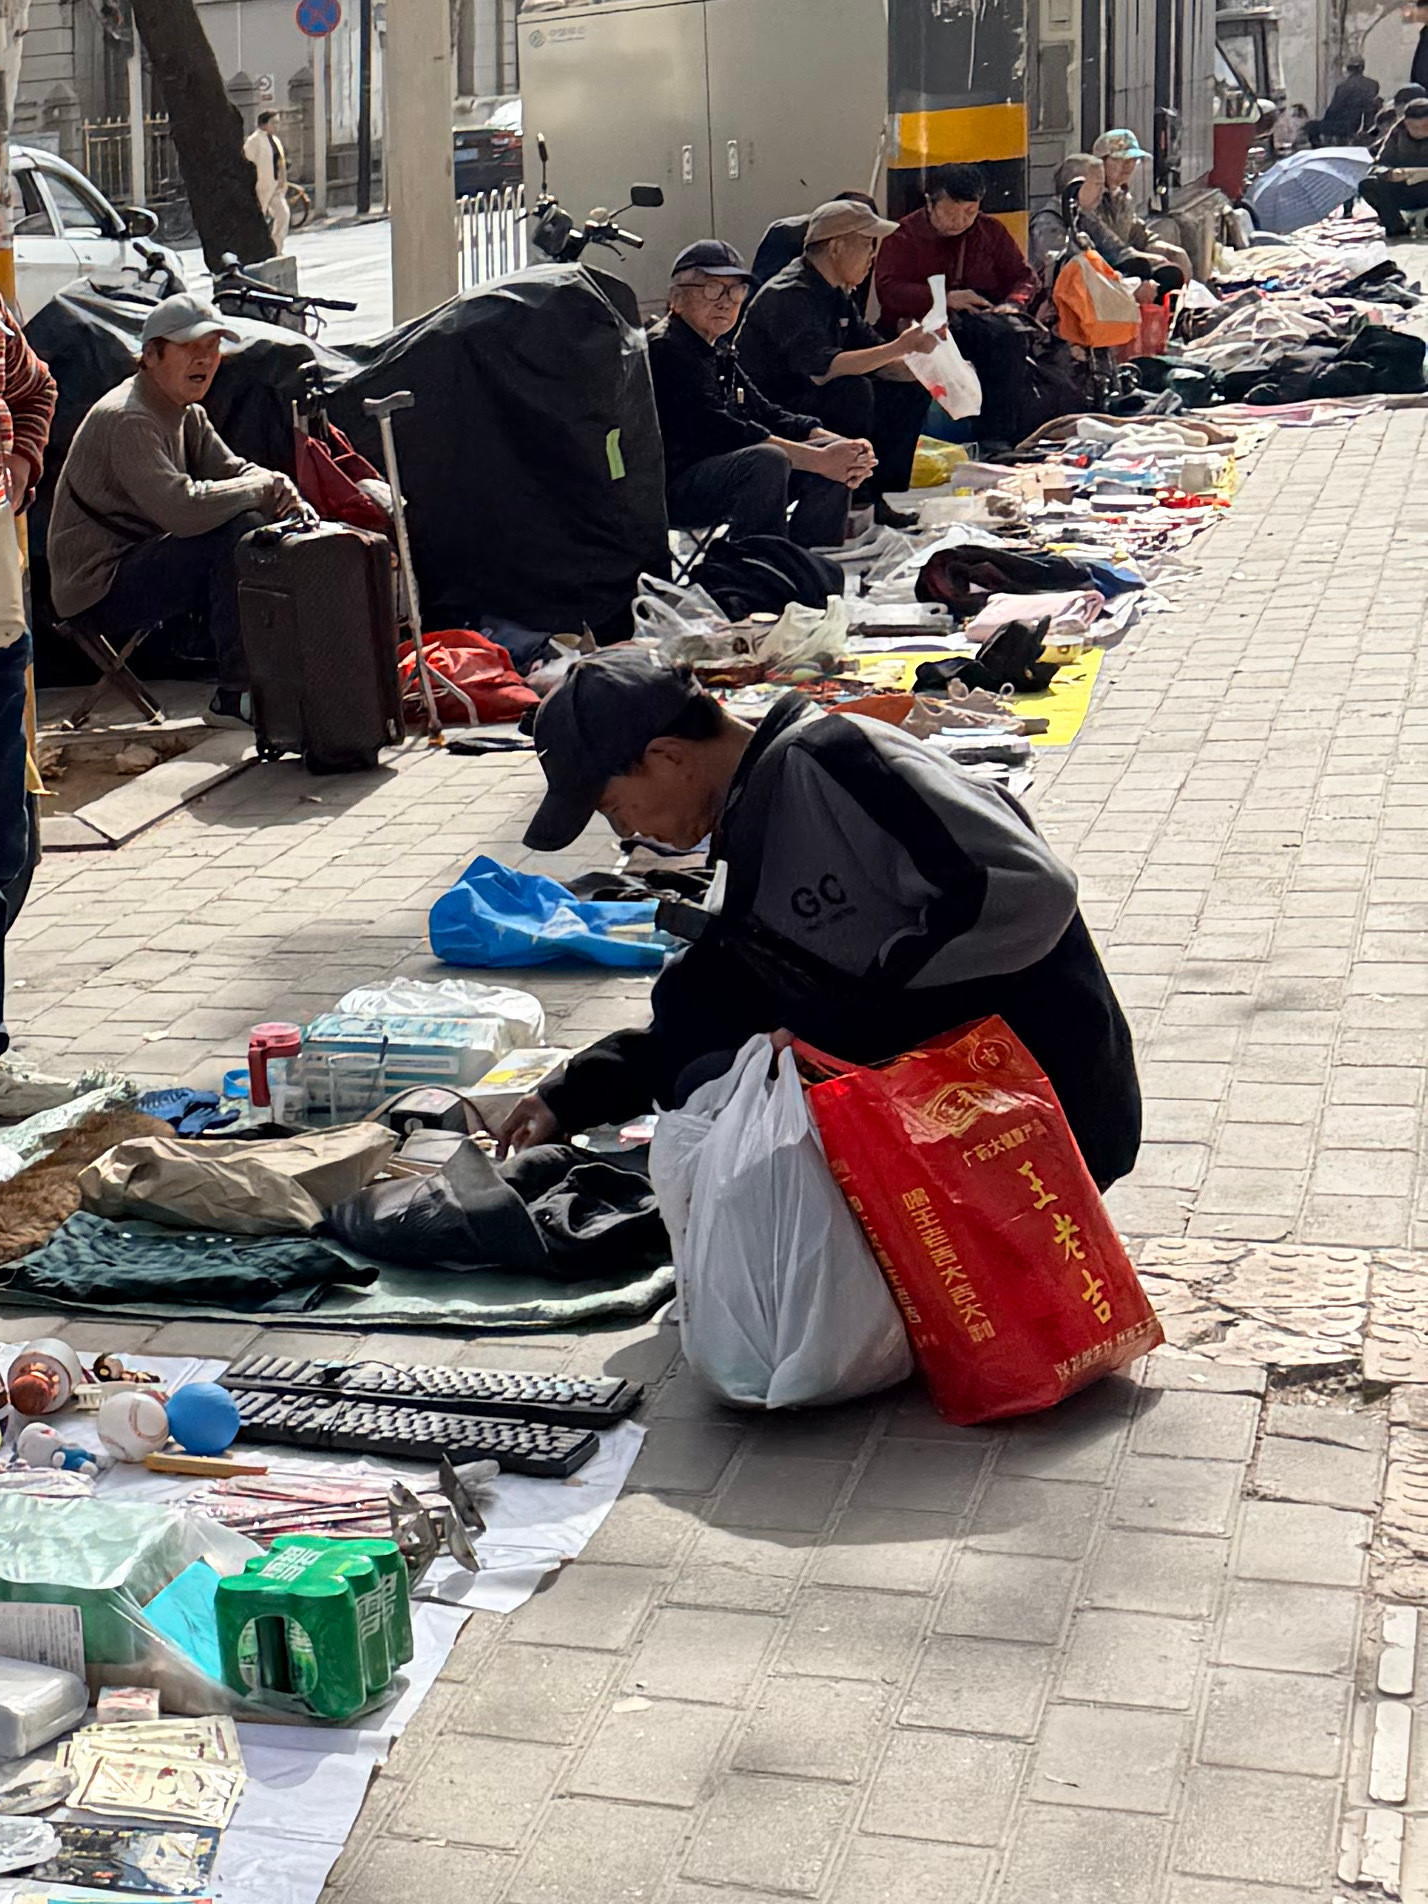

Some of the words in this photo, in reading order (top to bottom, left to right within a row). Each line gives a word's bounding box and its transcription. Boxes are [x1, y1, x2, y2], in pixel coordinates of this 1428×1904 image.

[901, 1187, 997, 1344] 喝王老吉大吉大利
[1017, 1160, 1113, 1325] 王老吉
